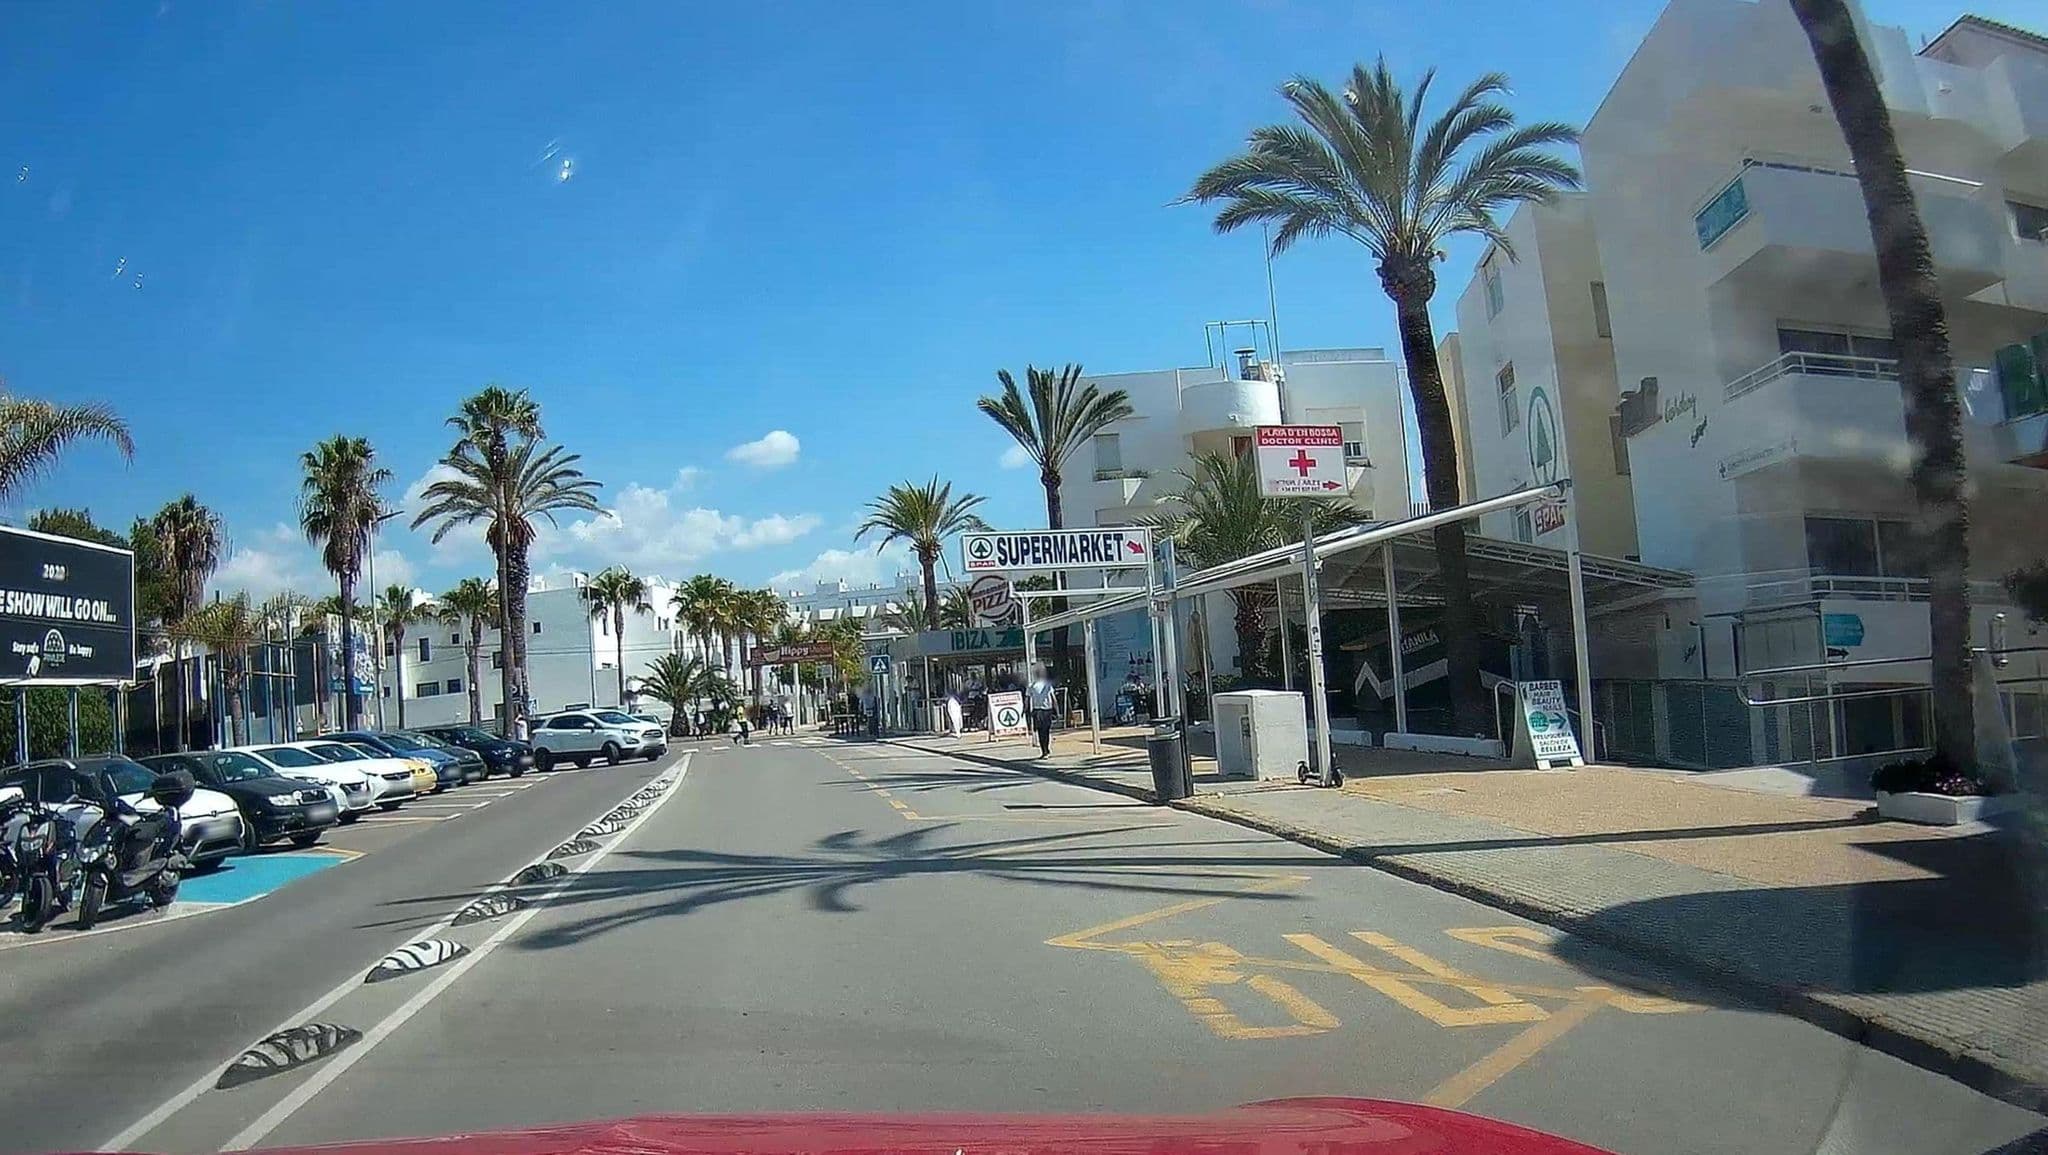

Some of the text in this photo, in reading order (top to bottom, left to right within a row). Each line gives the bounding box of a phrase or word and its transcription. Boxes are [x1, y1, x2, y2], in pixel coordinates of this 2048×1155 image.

[997, 533, 1123, 566] SUPERMARKET
[5, 590, 45, 616] SHOW
[46, 594, 73, 618] WILL
[75, 598, 91, 620] GO
[951, 630, 990, 651] IBIZA
